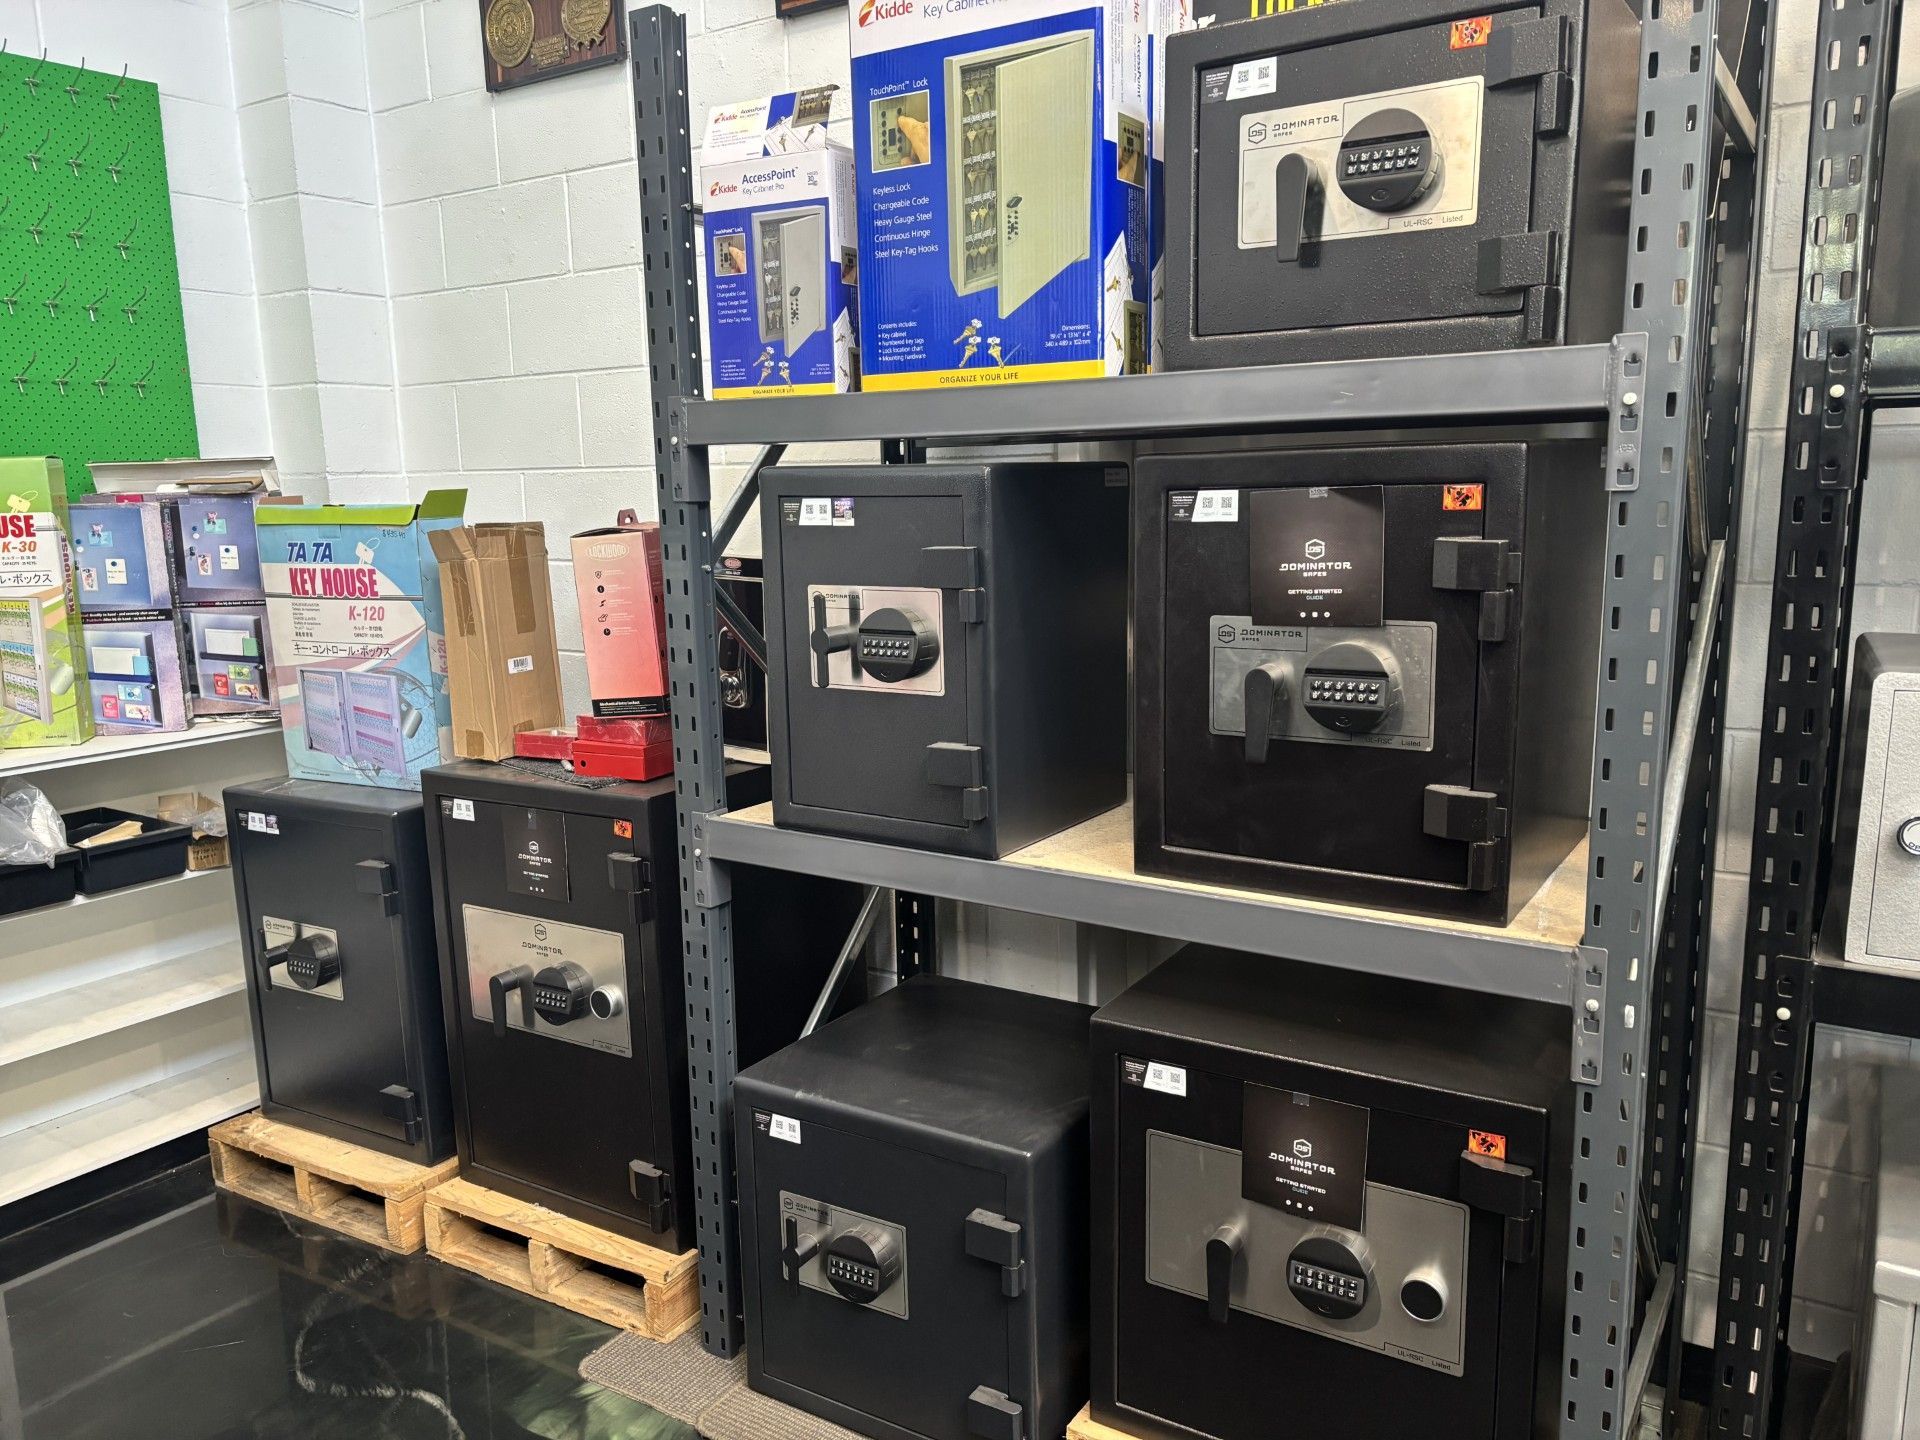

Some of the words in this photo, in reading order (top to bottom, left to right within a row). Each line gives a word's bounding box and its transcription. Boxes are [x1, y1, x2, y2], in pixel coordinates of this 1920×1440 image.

[875, 1, 913, 21] Kidde
[923, 4, 943, 19] Key
[912, 77, 928, 88] Lock
[721, 113, 738, 122] Kidde
[1272, 115, 1340, 131] DOMINATOR
[718, 183, 738, 194] Kidde
[742, 187, 752, 195] Key
[753, 185, 774, 194] Cabinet
[774, 183, 785, 191] Pro
[873, 186, 896, 197] Keyless
[896, 182, 911, 192] Lock
[873, 199, 910, 212] Changeable
[911, 196, 930, 206] Code
[874, 217, 893, 227] Heavy
[894, 215, 915, 225] Gauge
[916, 211, 933, 221] Steel
[1403, 217, 1433, 229] UL-RSC
[1442, 214, 1463, 224] Listed
[874, 232, 910, 243] Continuous
[912, 229, 931, 239] Hinge
[875, 249, 890, 259] Steel
[891, 246, 917, 258] Key-Tag
[918, 244, 939, 253] Hooks
[940, 375, 977, 384] ORGANIZE
[980, 372, 1002, 381] YOUR
[1003, 371, 1018, 380] LIFE
[0, 514, 36, 538] USE
[2, 541, 37, 553] K-30
[287, 542, 307, 563] TA
[312, 542, 333, 563] TA
[1279, 561, 1353, 571] DOMINATOR
[289, 567, 317, 597] KEY
[320, 567, 379, 598] HOUSE
[348, 605, 385, 621] K-120
[1240, 629, 1303, 638] DOMINATOR
[294, 642, 392, 658] キー・コントロール・ボックス
[437, 639, 449, 673] K-120
[521, 941, 563, 955] DOMINATOR
[1268, 1152, 1336, 1175] DOMINATOR
[1290, 1165, 1313, 1175] SAFES
[1397, 1349, 1424, 1362] UL-RSC
[1431, 1360, 1451, 1371] Listed
